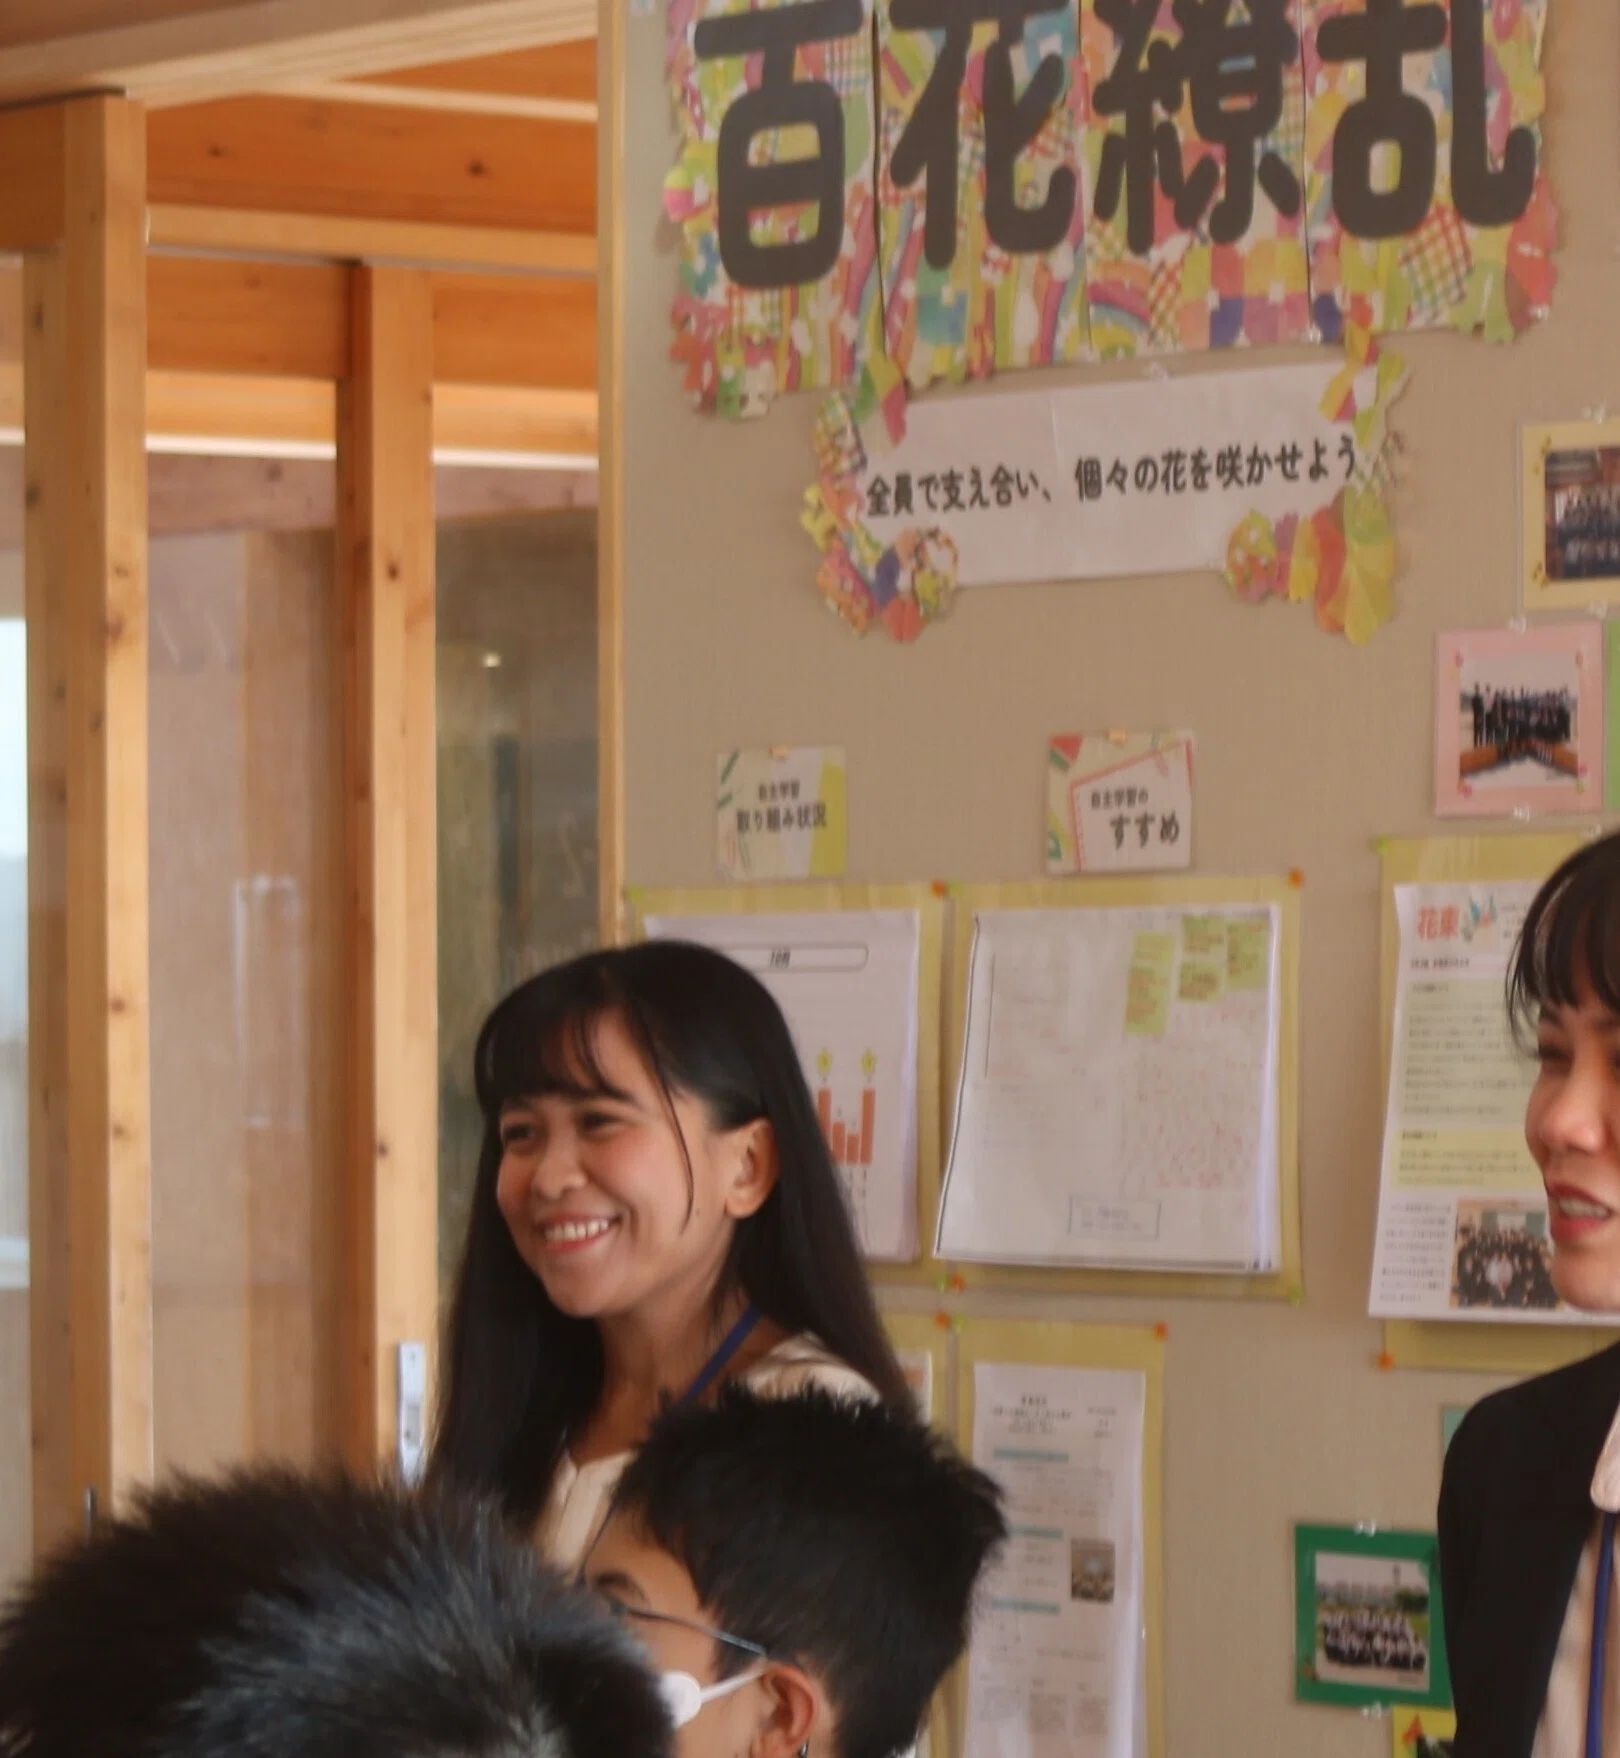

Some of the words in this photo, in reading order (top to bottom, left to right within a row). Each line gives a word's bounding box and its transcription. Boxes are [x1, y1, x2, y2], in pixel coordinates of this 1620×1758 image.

[694, 0, 1536, 290] 百花繚乱
[736, 805, 828, 835] 取り組み状況
[1108, 811, 1181, 850] すすめ
